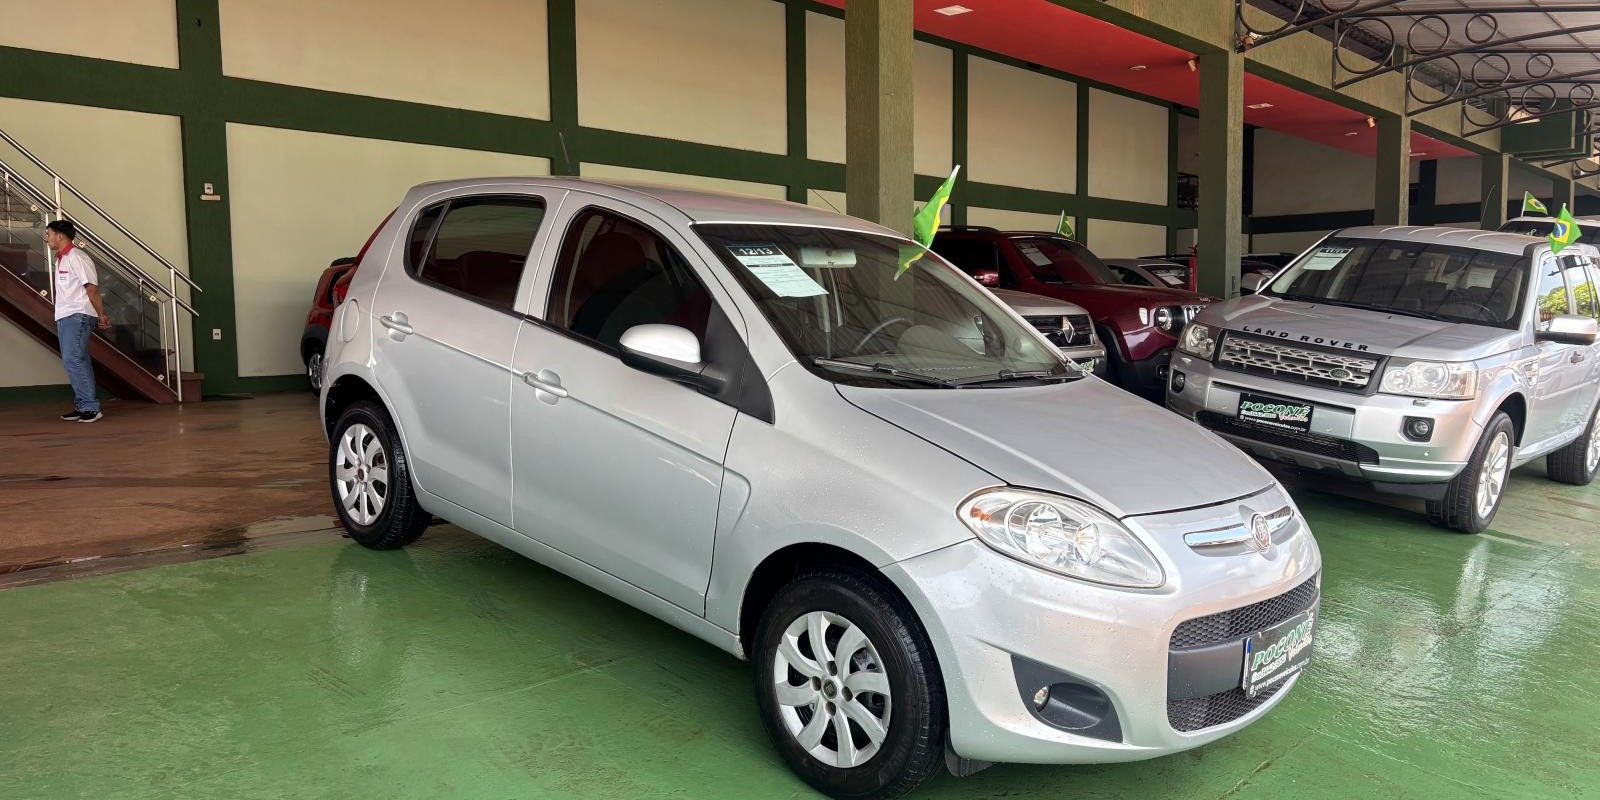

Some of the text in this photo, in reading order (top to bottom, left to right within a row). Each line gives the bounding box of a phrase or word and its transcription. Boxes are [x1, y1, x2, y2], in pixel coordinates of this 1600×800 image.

[739, 247, 773, 255] 12/13
[1243, 325, 1369, 351] LAND ROVER
